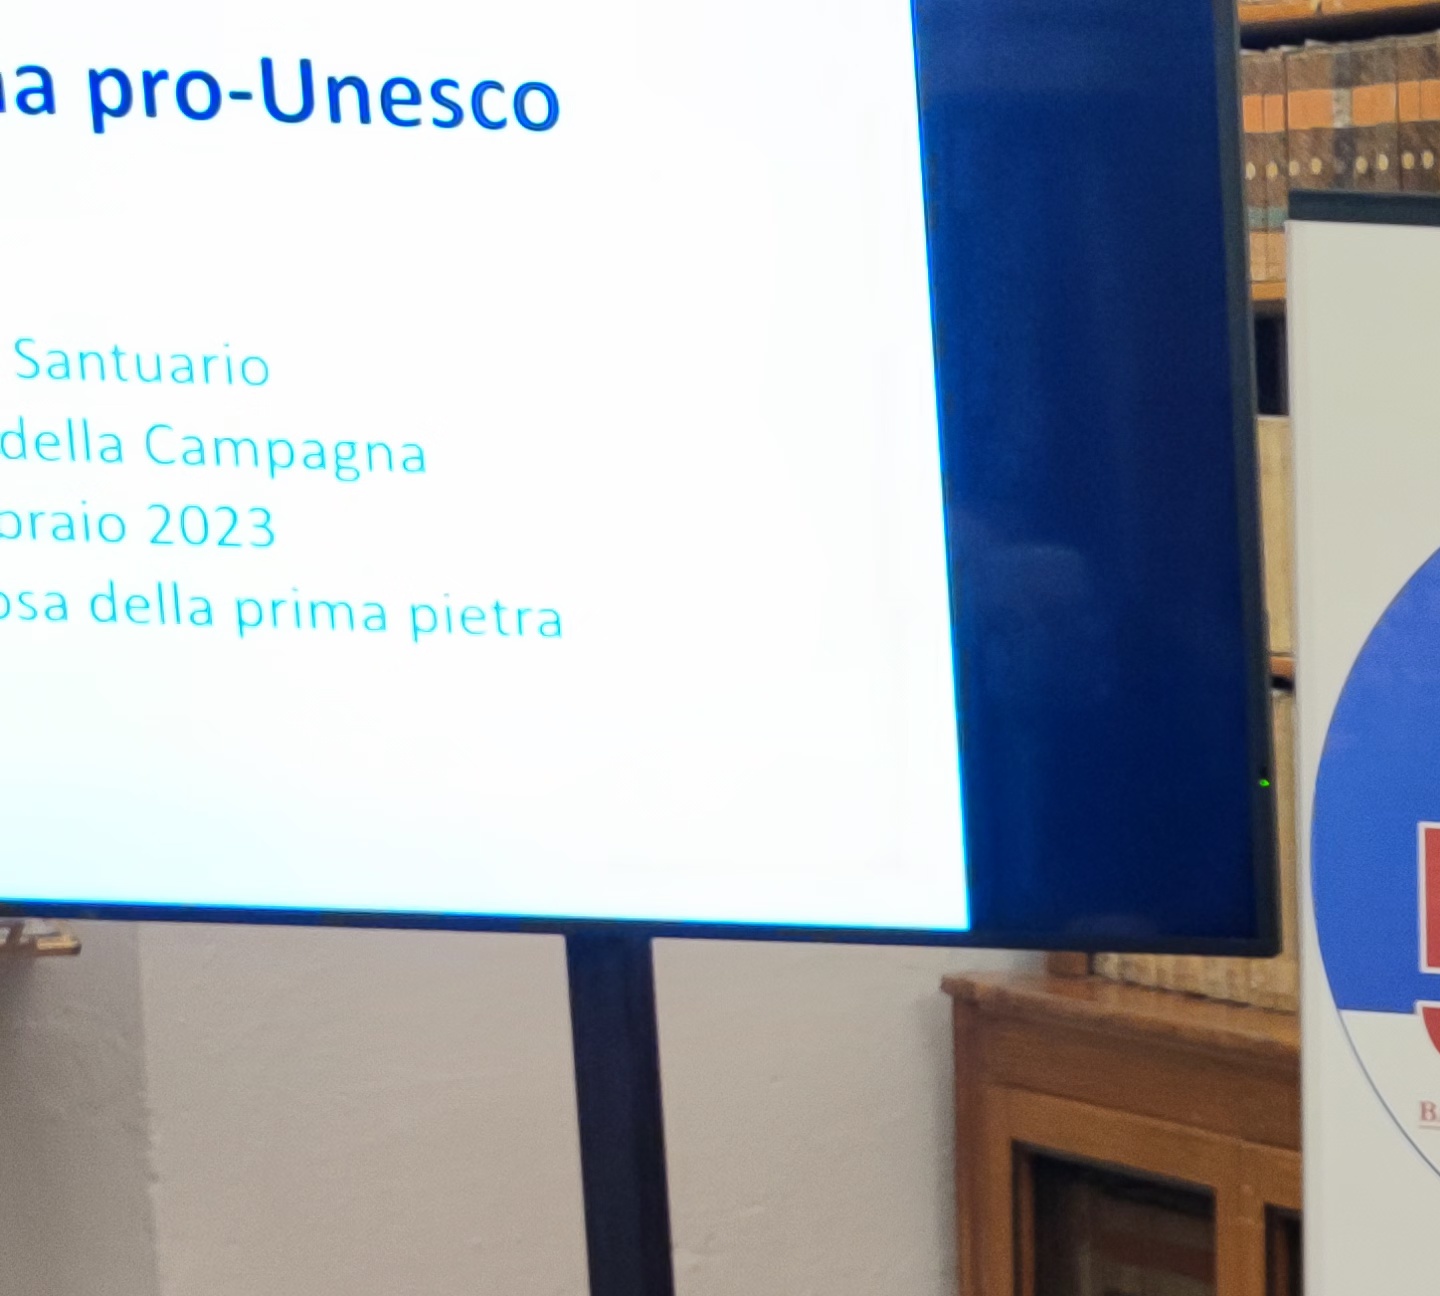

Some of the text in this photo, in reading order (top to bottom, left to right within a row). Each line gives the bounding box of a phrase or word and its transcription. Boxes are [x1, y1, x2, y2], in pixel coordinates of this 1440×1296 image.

[0, 55, 562, 134] a pro-Unesco
[13, 337, 271, 388] Santuario
[0, 415, 428, 483] della Campagna
[147, 503, 276, 549] 2023
[89, 578, 214, 628] della
[235, 587, 389, 640] prima
[409, 592, 564, 644] pietra
